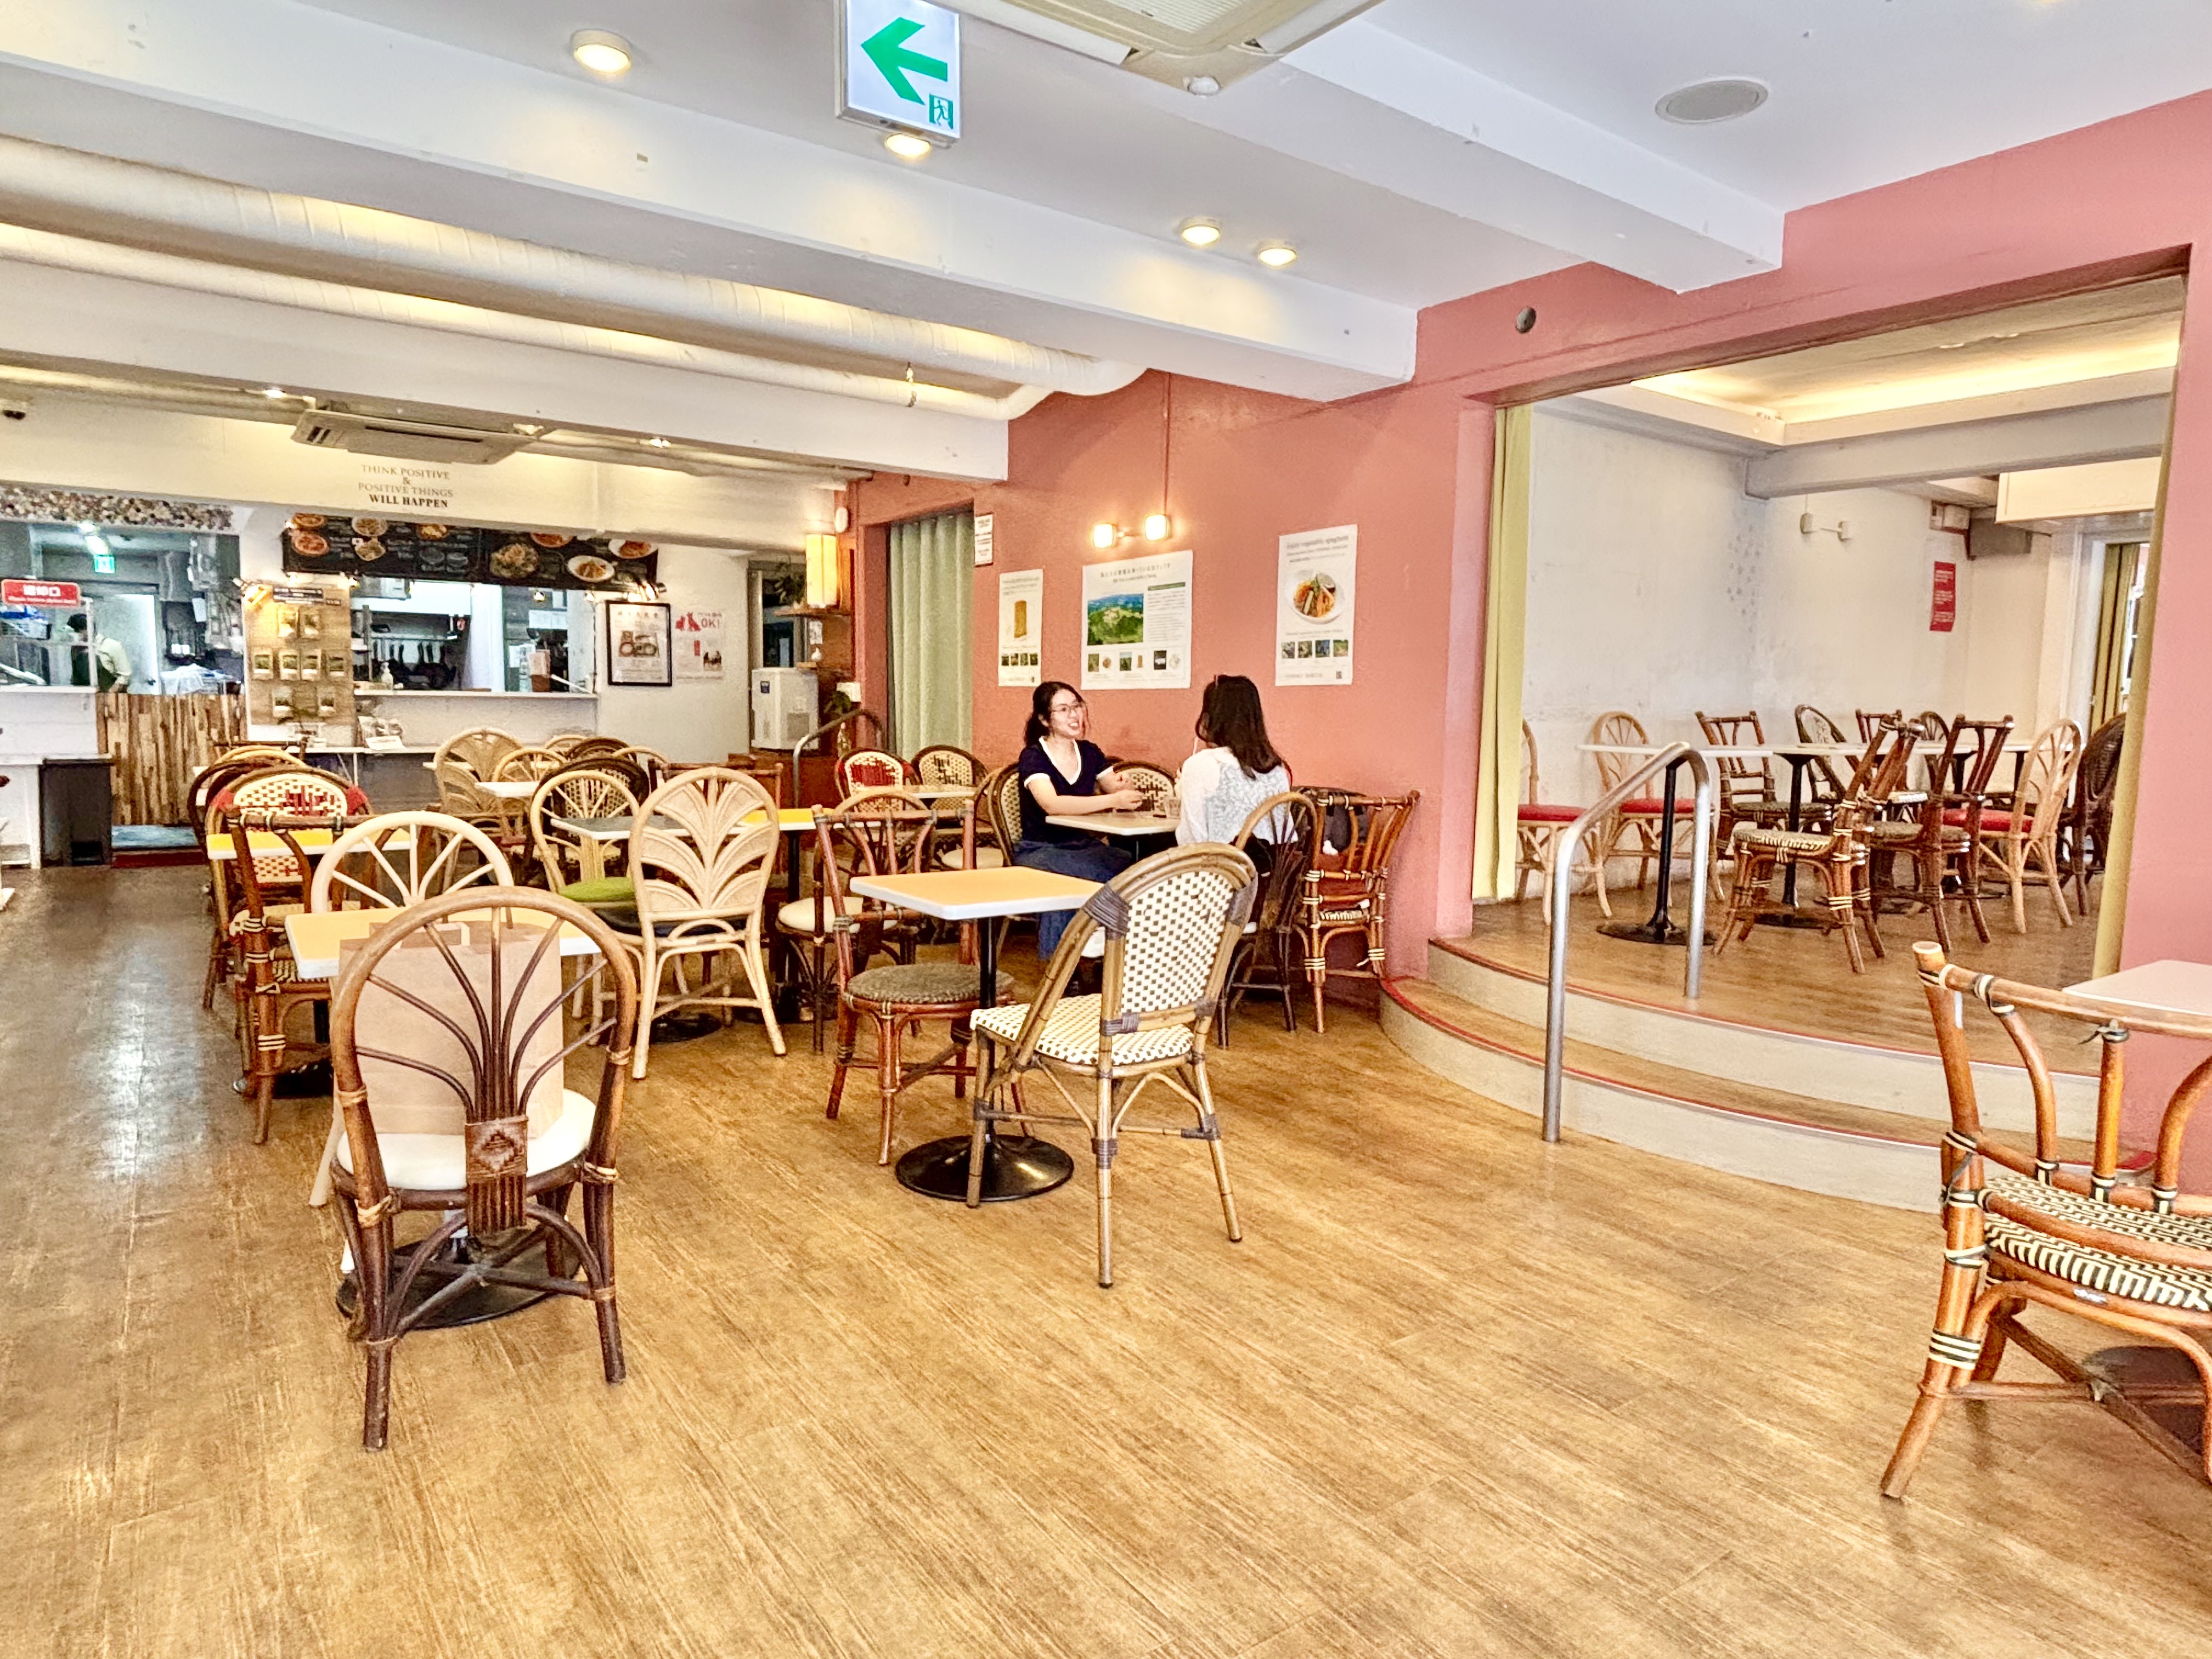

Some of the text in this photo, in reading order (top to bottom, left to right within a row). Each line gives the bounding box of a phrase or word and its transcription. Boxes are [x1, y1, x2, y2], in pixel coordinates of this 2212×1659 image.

[361, 465, 449, 479] THINK POSITIVE
[403, 477, 411, 485] &
[358, 482, 453, 497] POSITIVE THINGS
[369, 494, 448, 508] WILL HAPPEN
